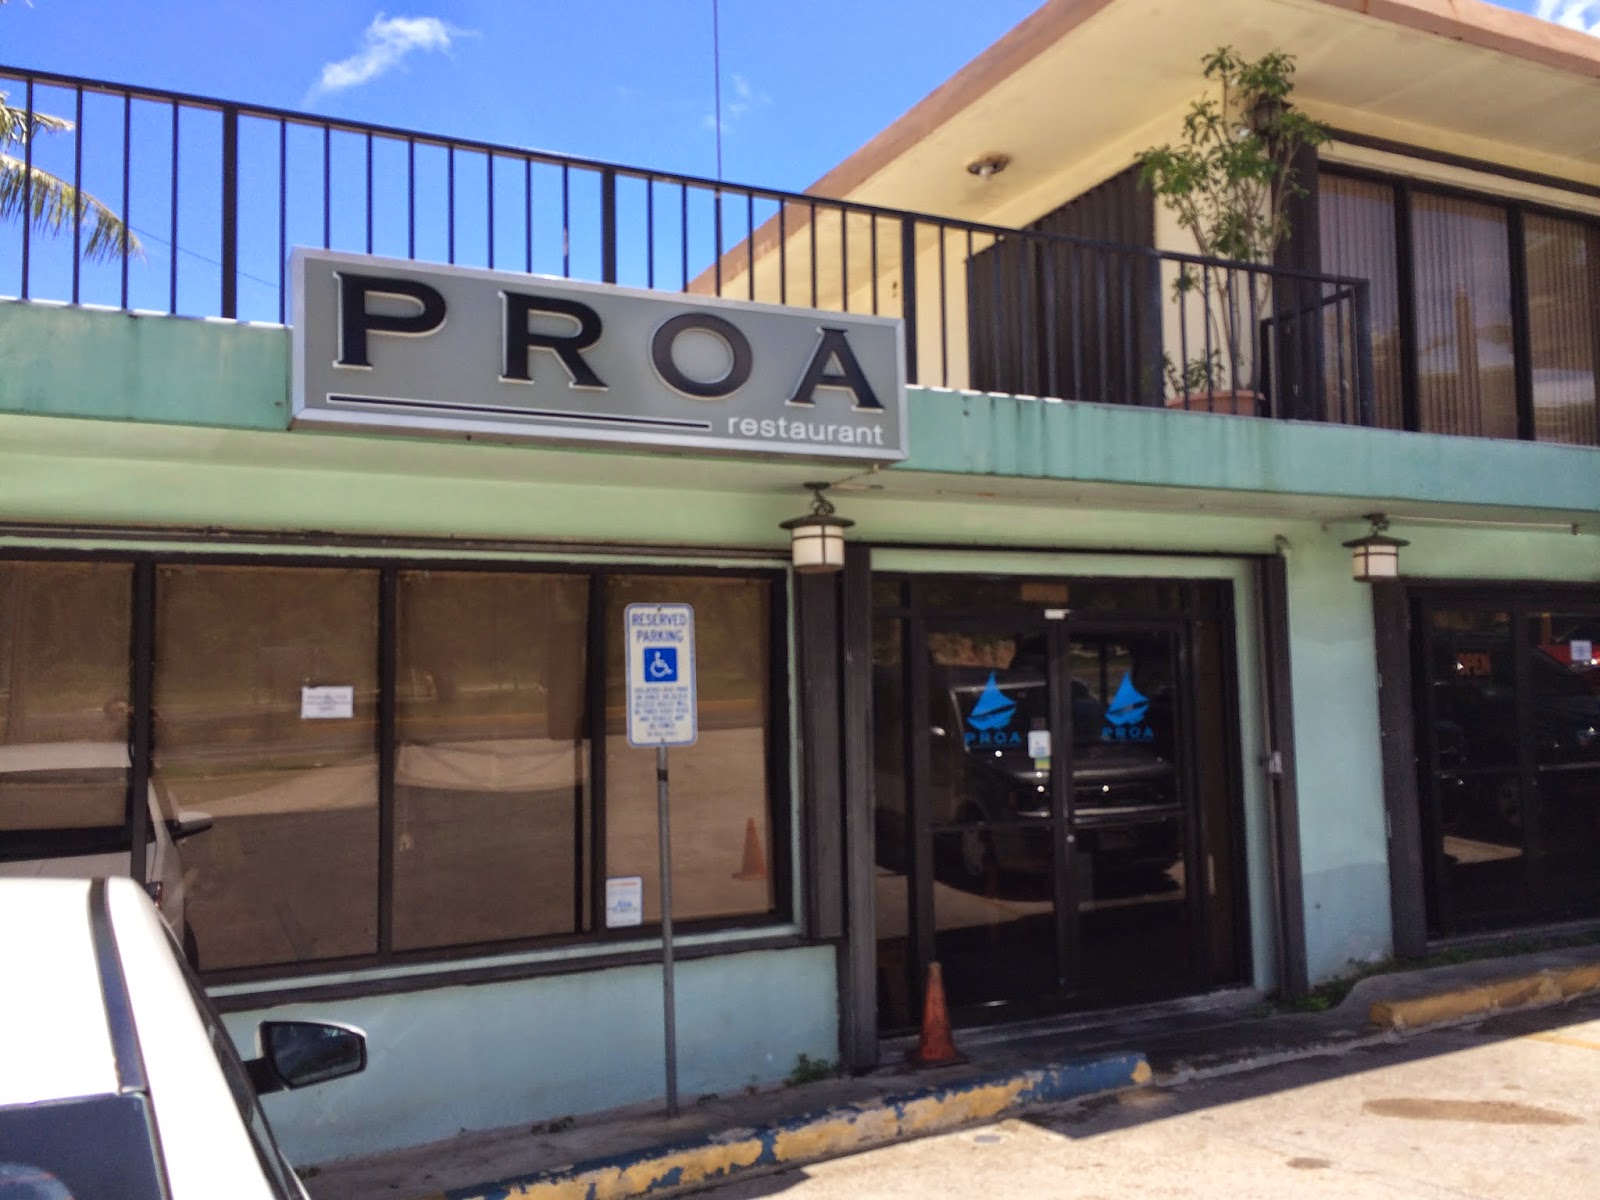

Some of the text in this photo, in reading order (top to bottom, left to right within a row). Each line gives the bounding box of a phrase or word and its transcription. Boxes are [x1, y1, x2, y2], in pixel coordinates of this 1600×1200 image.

[333, 271, 884, 412] PROA
[727, 413, 884, 446] restaurant
[631, 612, 688, 627] RESERVED
[636, 628, 685, 642] PARKING
[964, 730, 1022, 746] PROA
[1101, 726, 1154, 742] PROA
